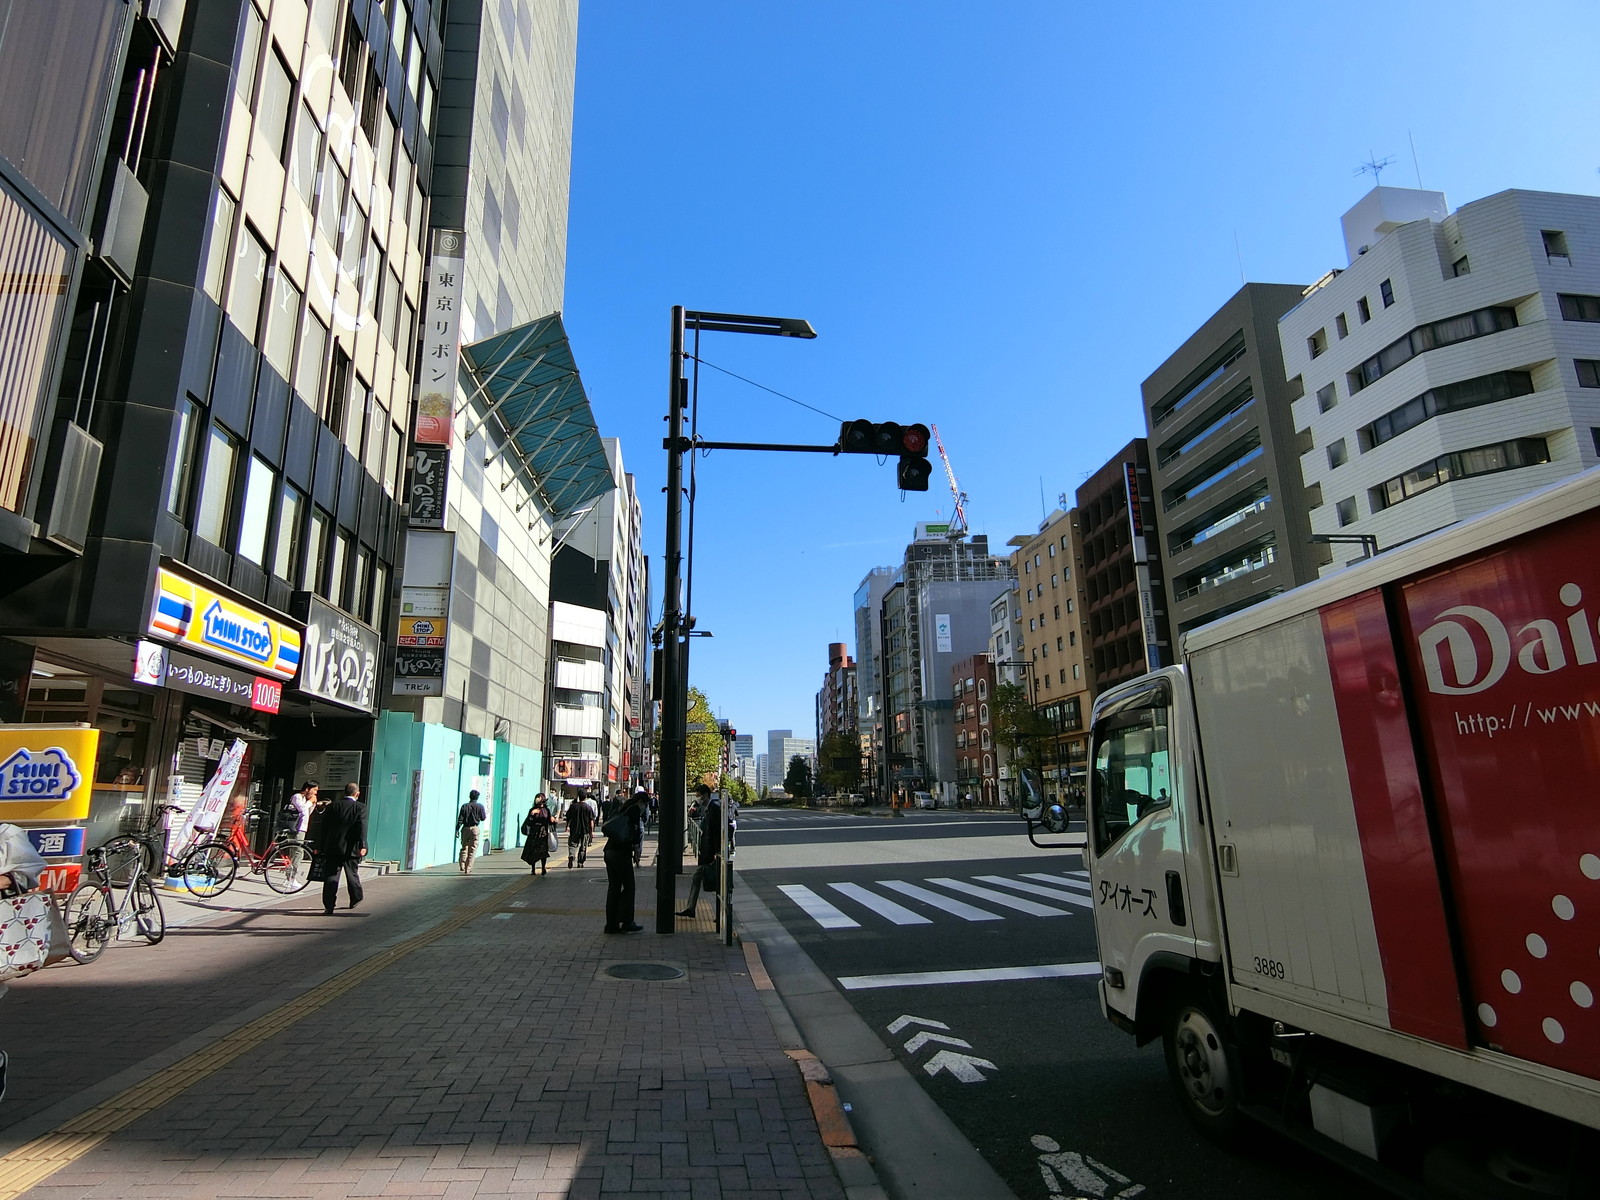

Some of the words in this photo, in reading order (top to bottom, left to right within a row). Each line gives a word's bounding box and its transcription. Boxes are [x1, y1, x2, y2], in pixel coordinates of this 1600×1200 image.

[431, 272, 455, 383] 東京リボン
[212, 615, 240, 643] MINI
[241, 627, 269, 653] STOP
[399, 636, 416, 645] たばこ
[427, 637, 445, 645] ATM
[1418, 582, 1600, 695] Dai
[169, 663, 232, 694] いつものおにぎり
[234, 682, 253, 699] いつも
[405, 683, 431, 691] TRビル
[12, 763, 61, 778] MINI
[8, 778, 61, 794] STOP
[38, 833, 66, 853] 酒
[37, 869, 67, 891] TM
[1099, 880, 1158, 920] ダイオーズ
[1253, 956, 1286, 980] 3889
